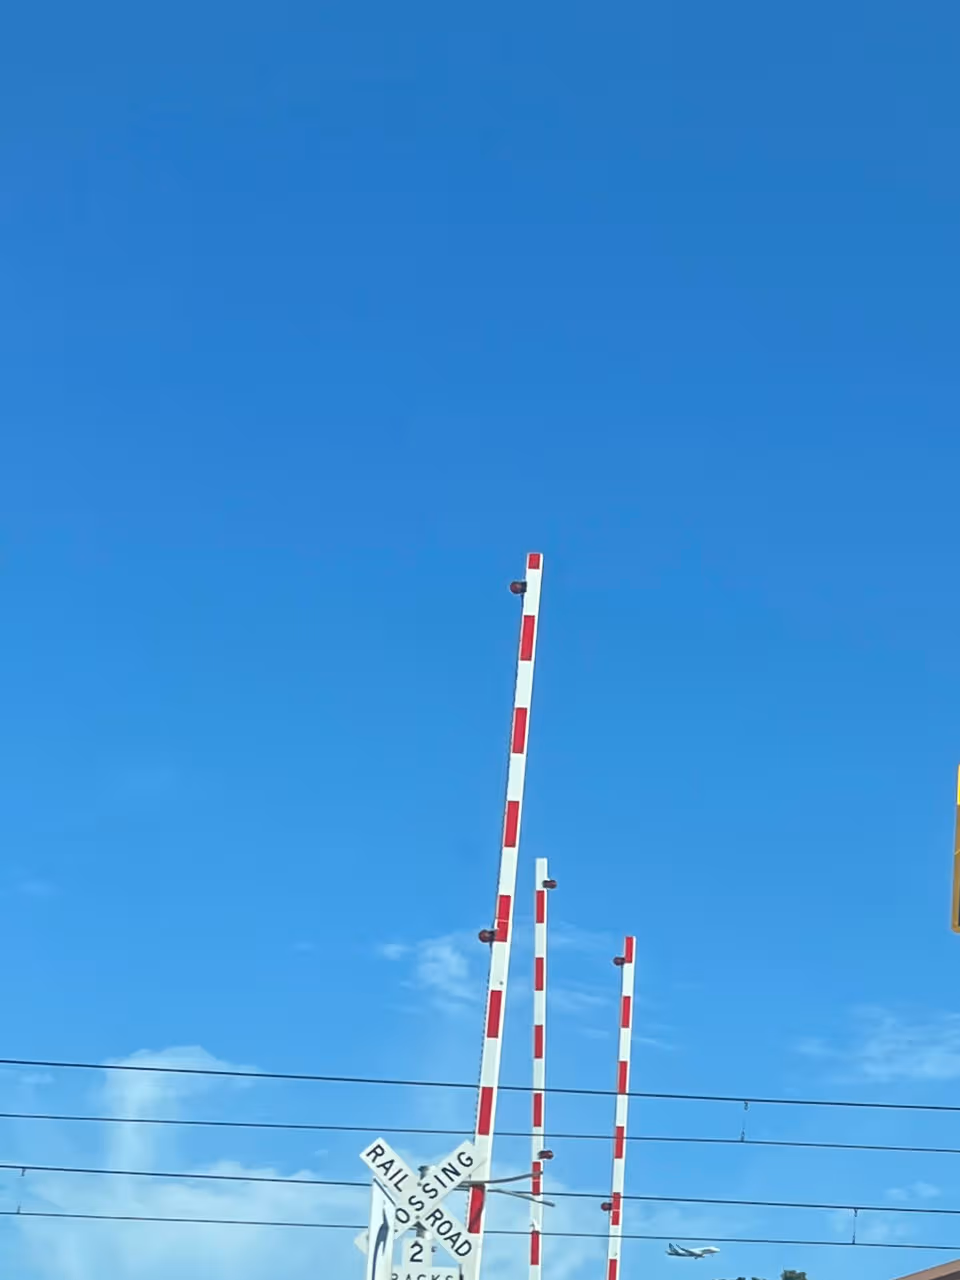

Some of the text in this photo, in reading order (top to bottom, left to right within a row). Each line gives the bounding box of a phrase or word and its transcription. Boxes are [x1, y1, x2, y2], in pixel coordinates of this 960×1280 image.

[366, 1144, 472, 1257] RAIL ROAD
[409, 1240, 424, 1263] 2
